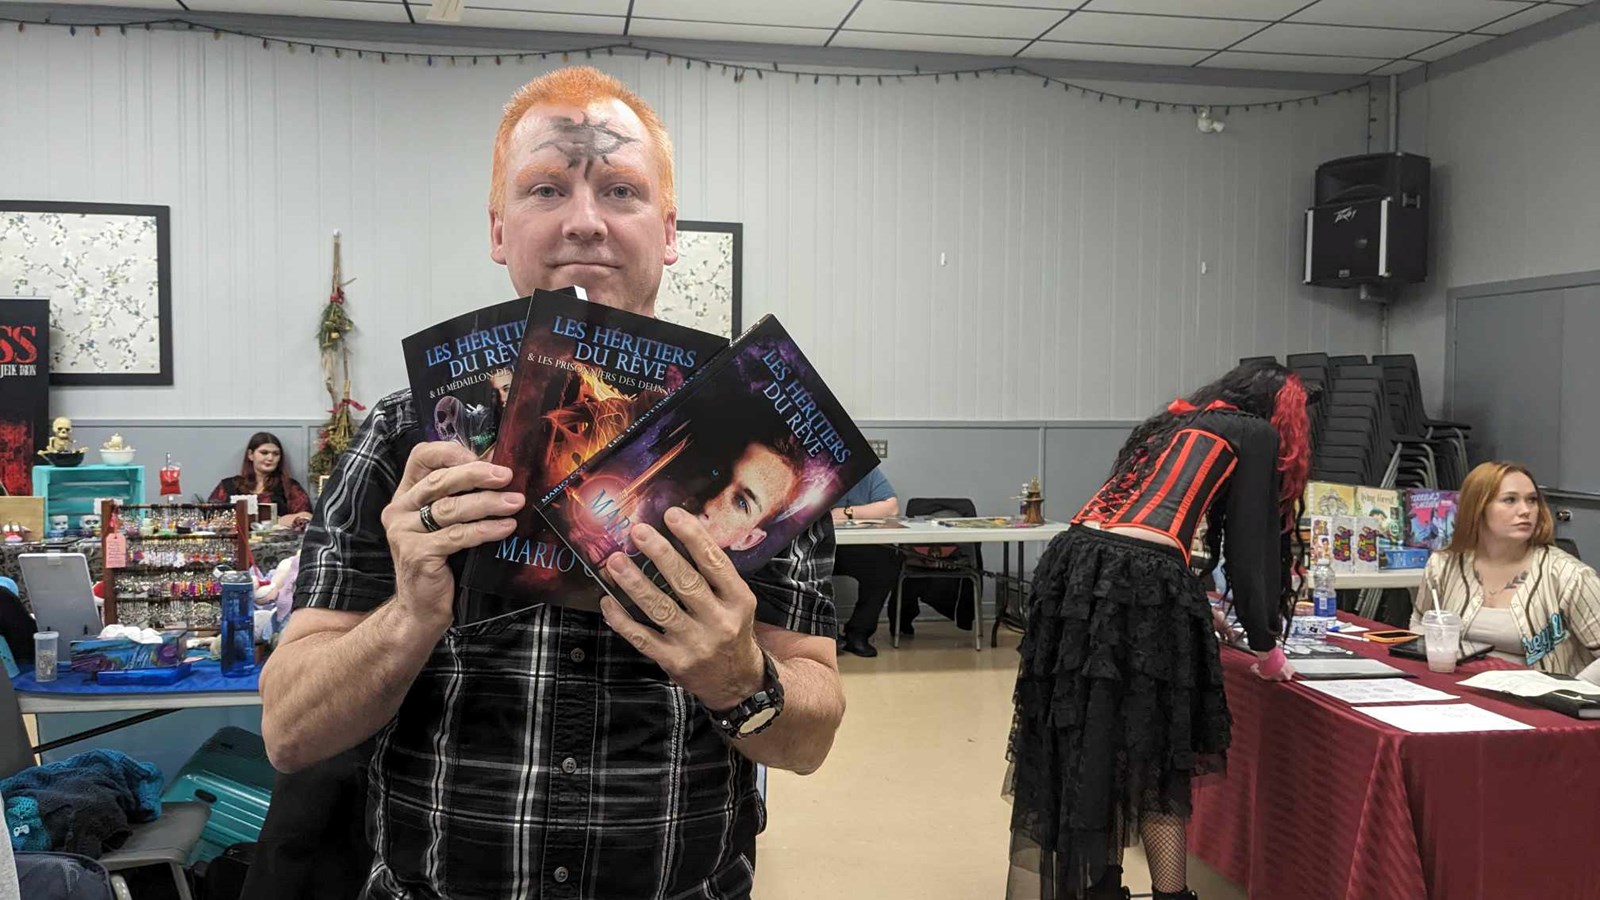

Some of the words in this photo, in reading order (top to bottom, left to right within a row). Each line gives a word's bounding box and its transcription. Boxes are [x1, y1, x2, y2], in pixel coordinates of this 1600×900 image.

[426, 342, 452, 367] LES
[553, 315, 588, 340] LES
[592, 326, 697, 368] HÉRITIERS
[449, 353, 480, 378] DU
[538, 355, 553, 366] LES
[555, 360, 617, 383] PRISONNIERS
[619, 375, 636, 387] DES
[575, 342, 610, 367] DU
[616, 352, 667, 381] RÊVE
[437, 386, 446, 396] LE
[496, 366, 511, 378] DE
[762, 349, 792, 381] LES
[785, 380, 851, 463] HÉRITIERS
[763, 381, 792, 414] DU
[786, 412, 824, 457] RÊVE
[541, 480, 569, 503] MARIO
[495, 536, 576, 573] MARIO
